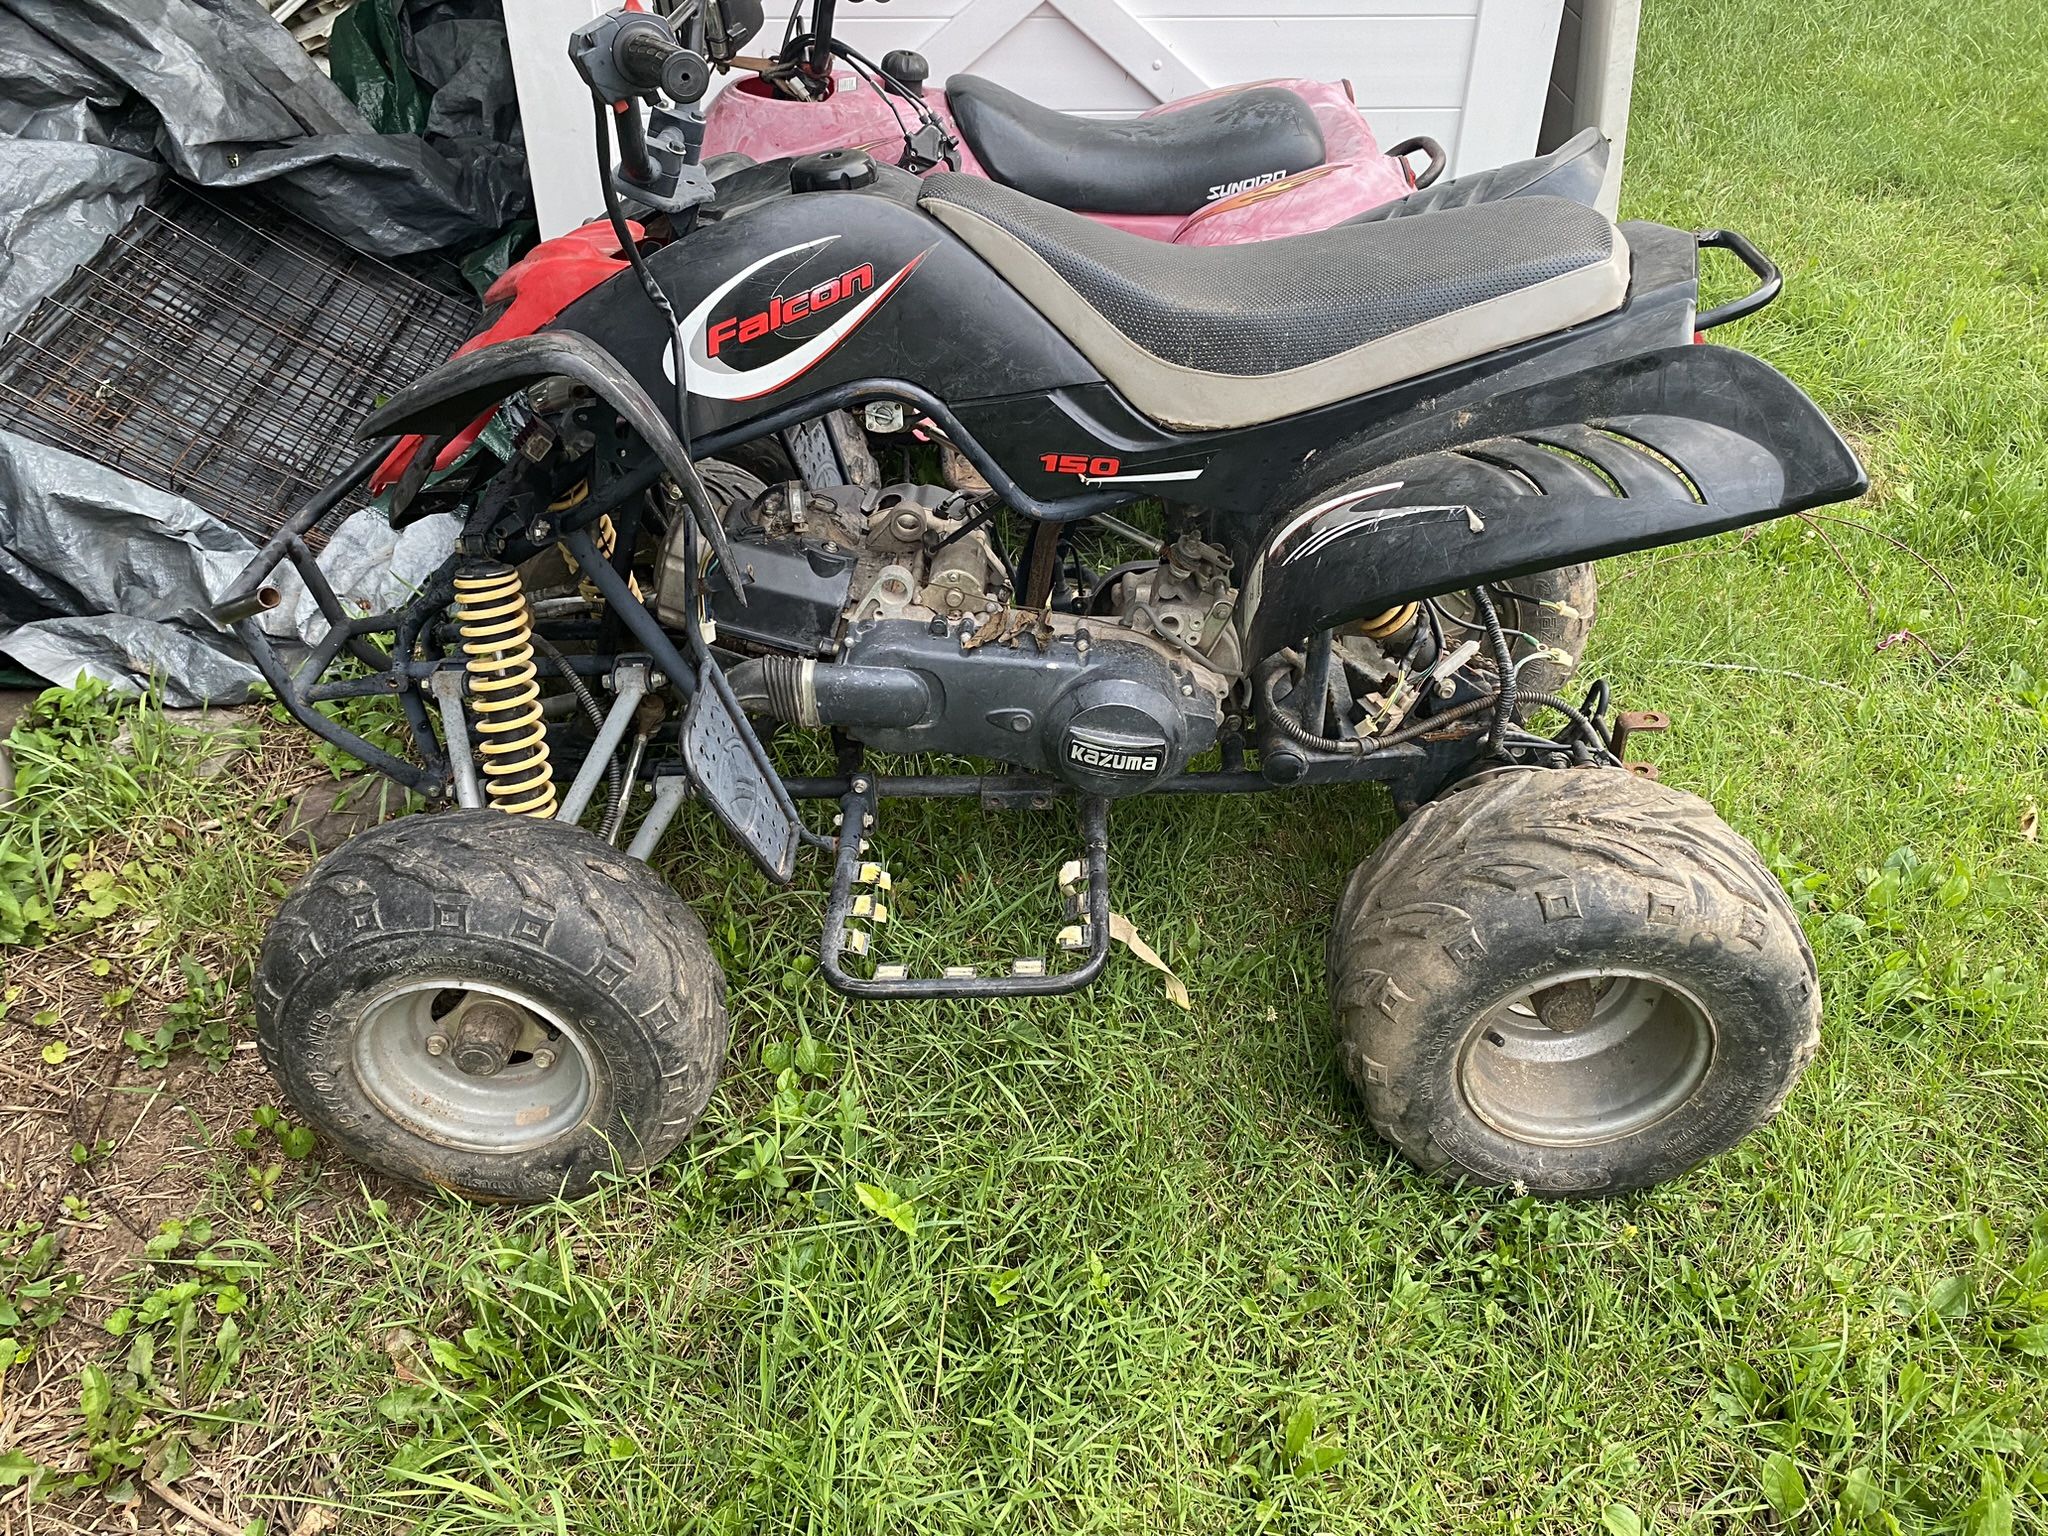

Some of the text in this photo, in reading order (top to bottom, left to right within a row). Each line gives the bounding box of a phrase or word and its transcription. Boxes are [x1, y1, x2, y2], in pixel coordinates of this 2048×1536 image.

[1206, 169, 1287, 200] SUNDIRO
[706, 261, 875, 358] Falcon
[1039, 453, 1120, 476] 150
[474, 959, 556, 992] TUBELESS
